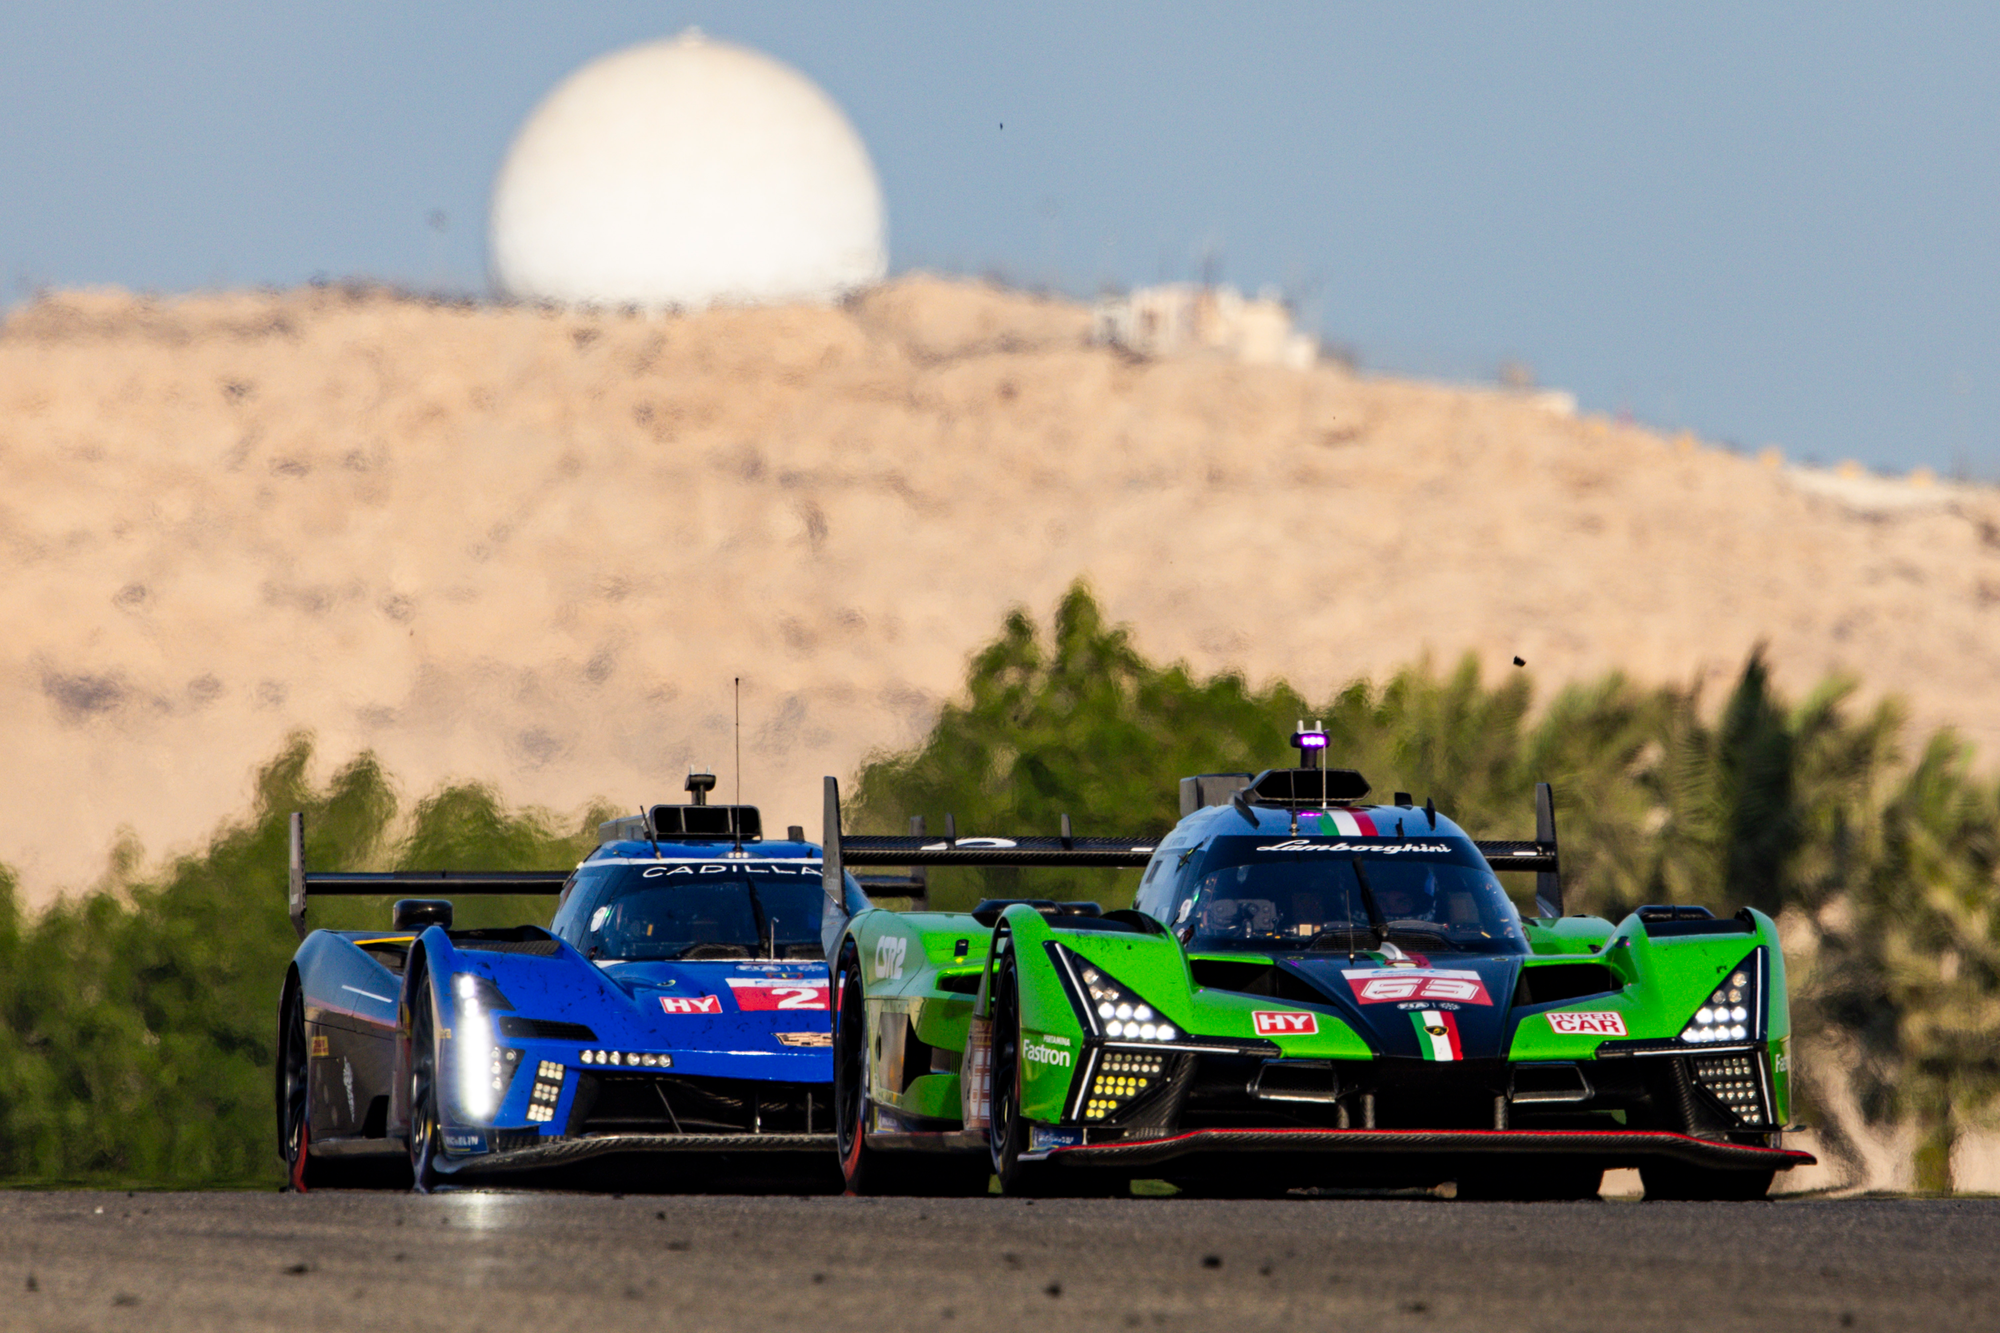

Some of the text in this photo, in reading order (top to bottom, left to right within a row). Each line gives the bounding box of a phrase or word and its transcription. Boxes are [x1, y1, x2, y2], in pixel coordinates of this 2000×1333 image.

[1256, 839, 1452, 855] Lamborghini
[643, 865, 823, 878] CADILLA
[1361, 978, 1479, 1000] 63
[664, 998, 714, 1012] HY
[771, 988, 825, 1009] 2
[1258, 1014, 1310, 1030] HY
[1555, 1020, 1621, 1033] CAR
[1022, 1039, 1071, 1067] Fastron
